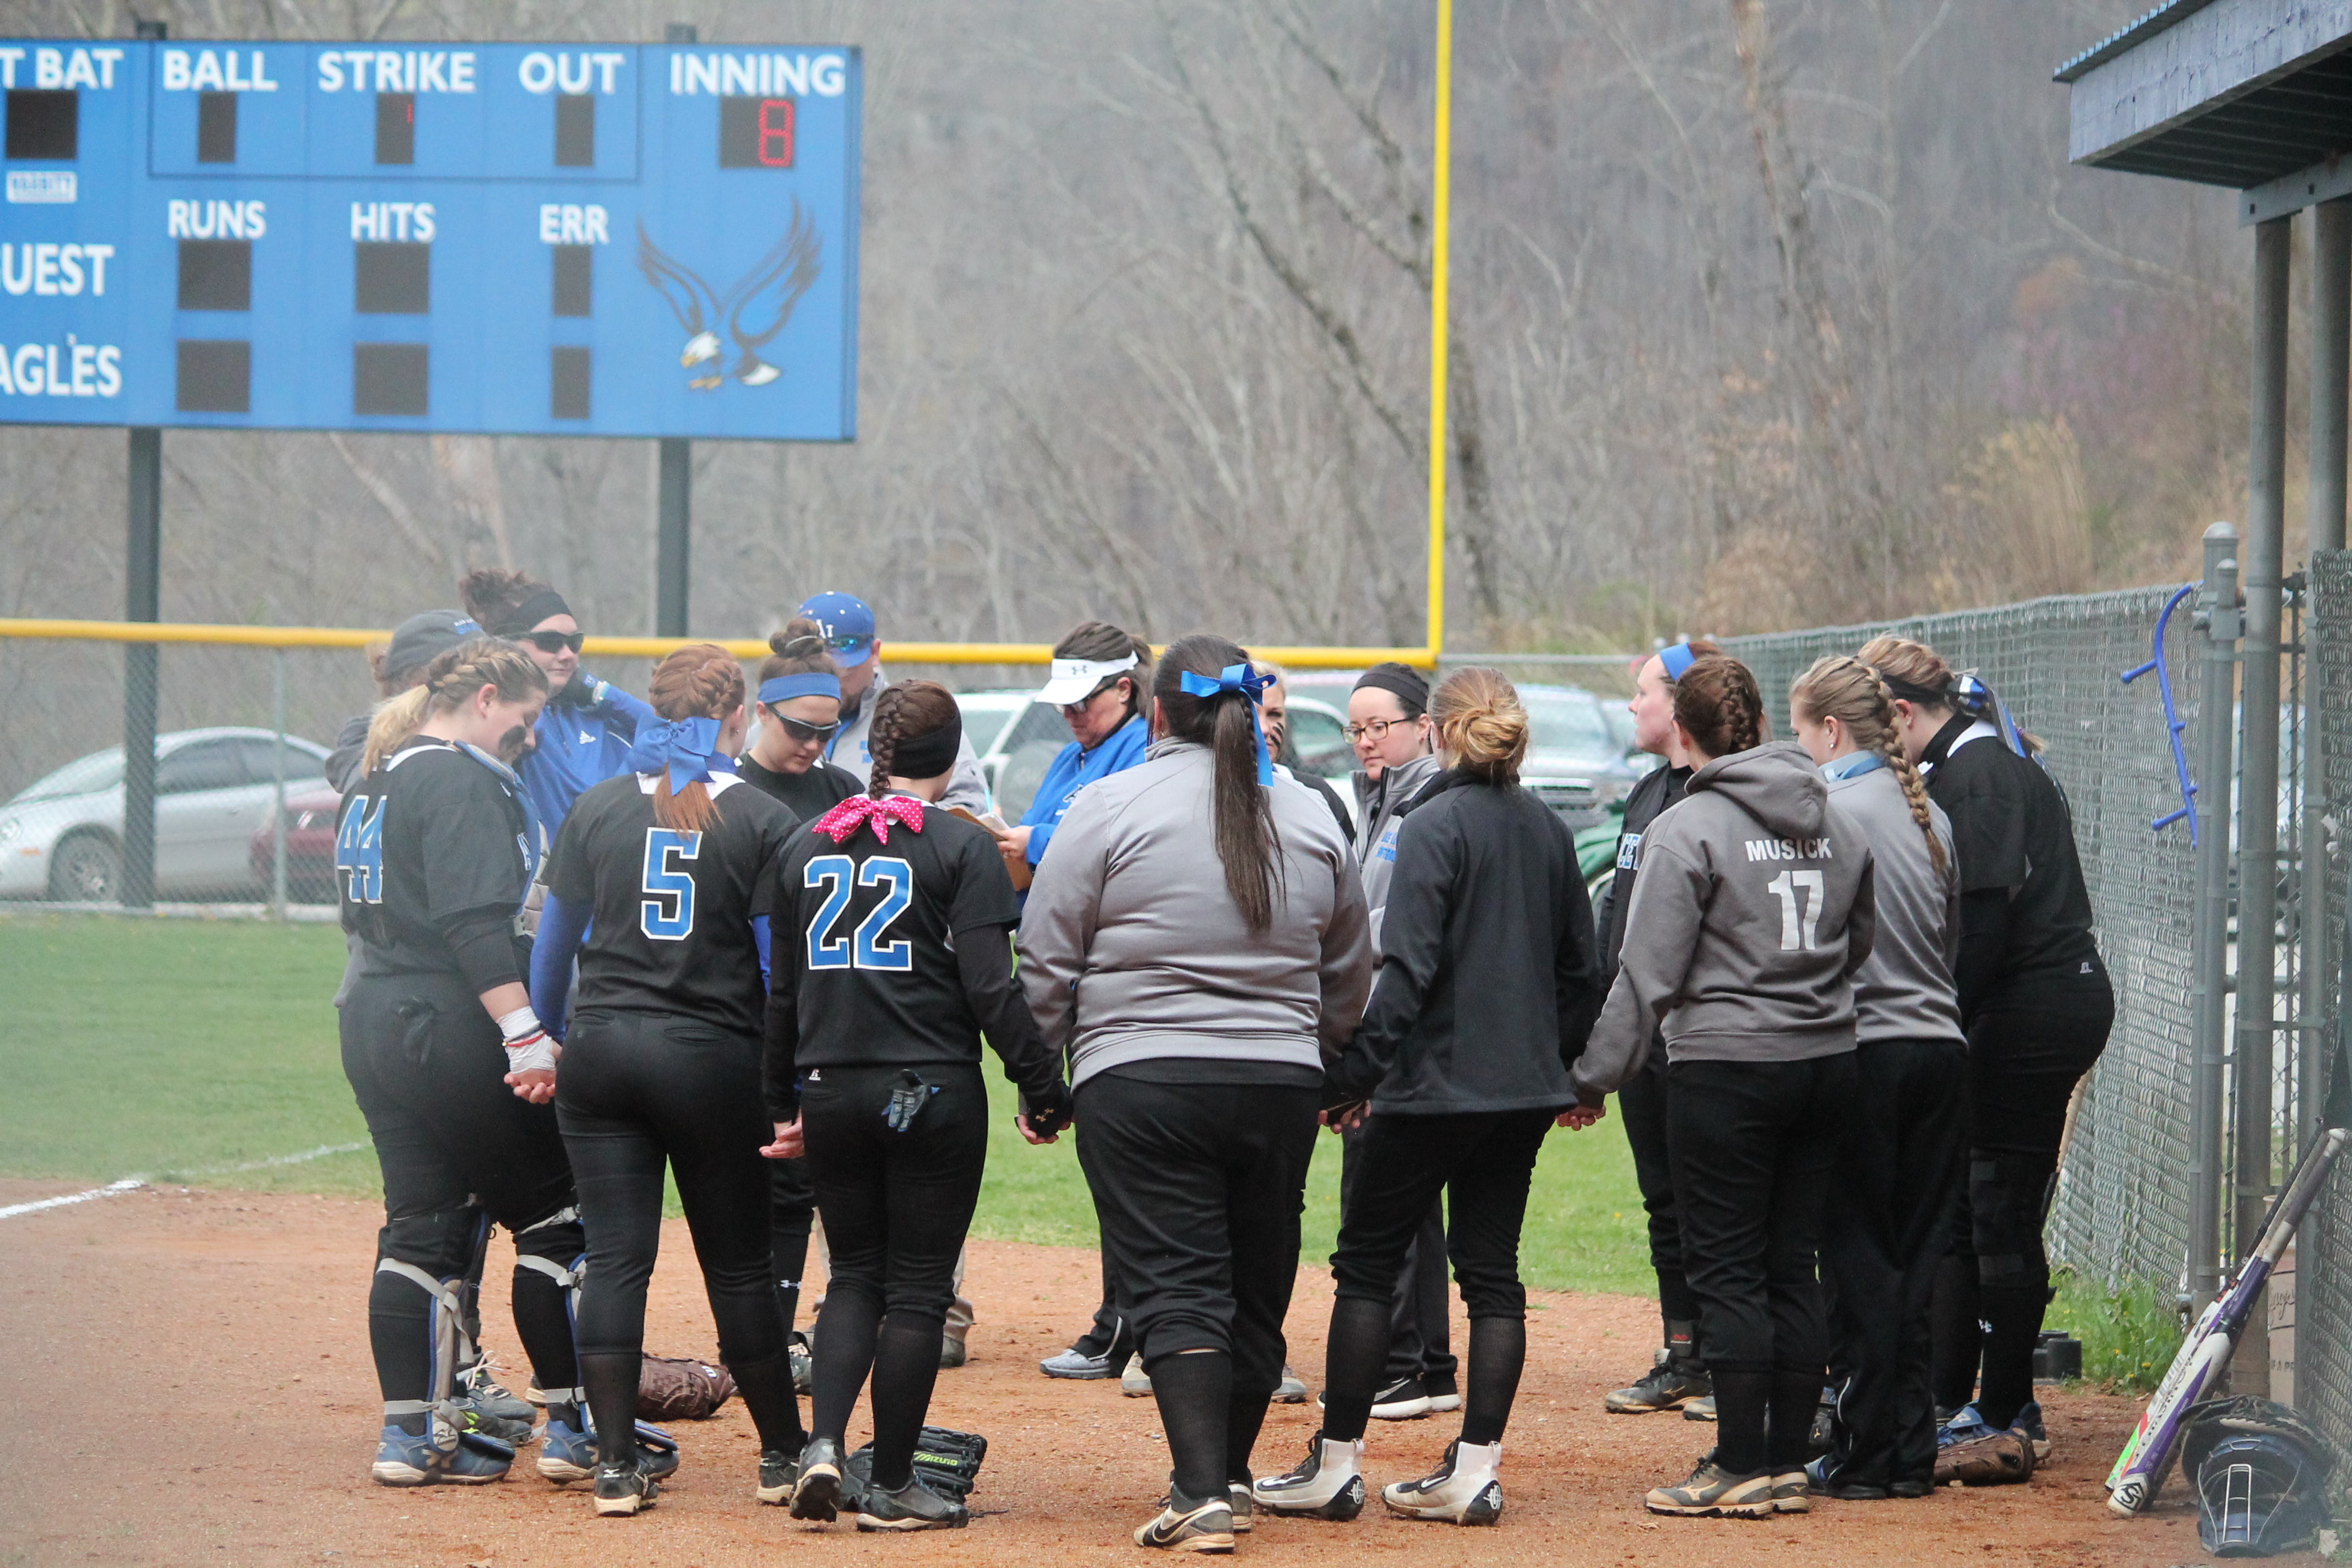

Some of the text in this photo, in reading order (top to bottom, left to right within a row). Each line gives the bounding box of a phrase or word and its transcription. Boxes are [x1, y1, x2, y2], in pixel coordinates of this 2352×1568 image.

[35, 48, 124, 89] BAT
[163, 50, 278, 91] BALL
[318, 51, 476, 93] STRIKE
[518, 52, 625, 95] OUT
[670, 53, 846, 97] INNING
[758, 99, 794, 167] 8
[168, 200, 266, 239] RUNS
[350, 202, 436, 243] HITS
[539, 204, 609, 244] ERR
[2, 243, 115, 296] UEST
[336, 794, 388, 905] 44
[1744, 837, 1833, 862] MUSICK
[640, 826, 704, 941] 5
[803, 853, 913, 972] 22
[1767, 869, 1825, 950] 17
